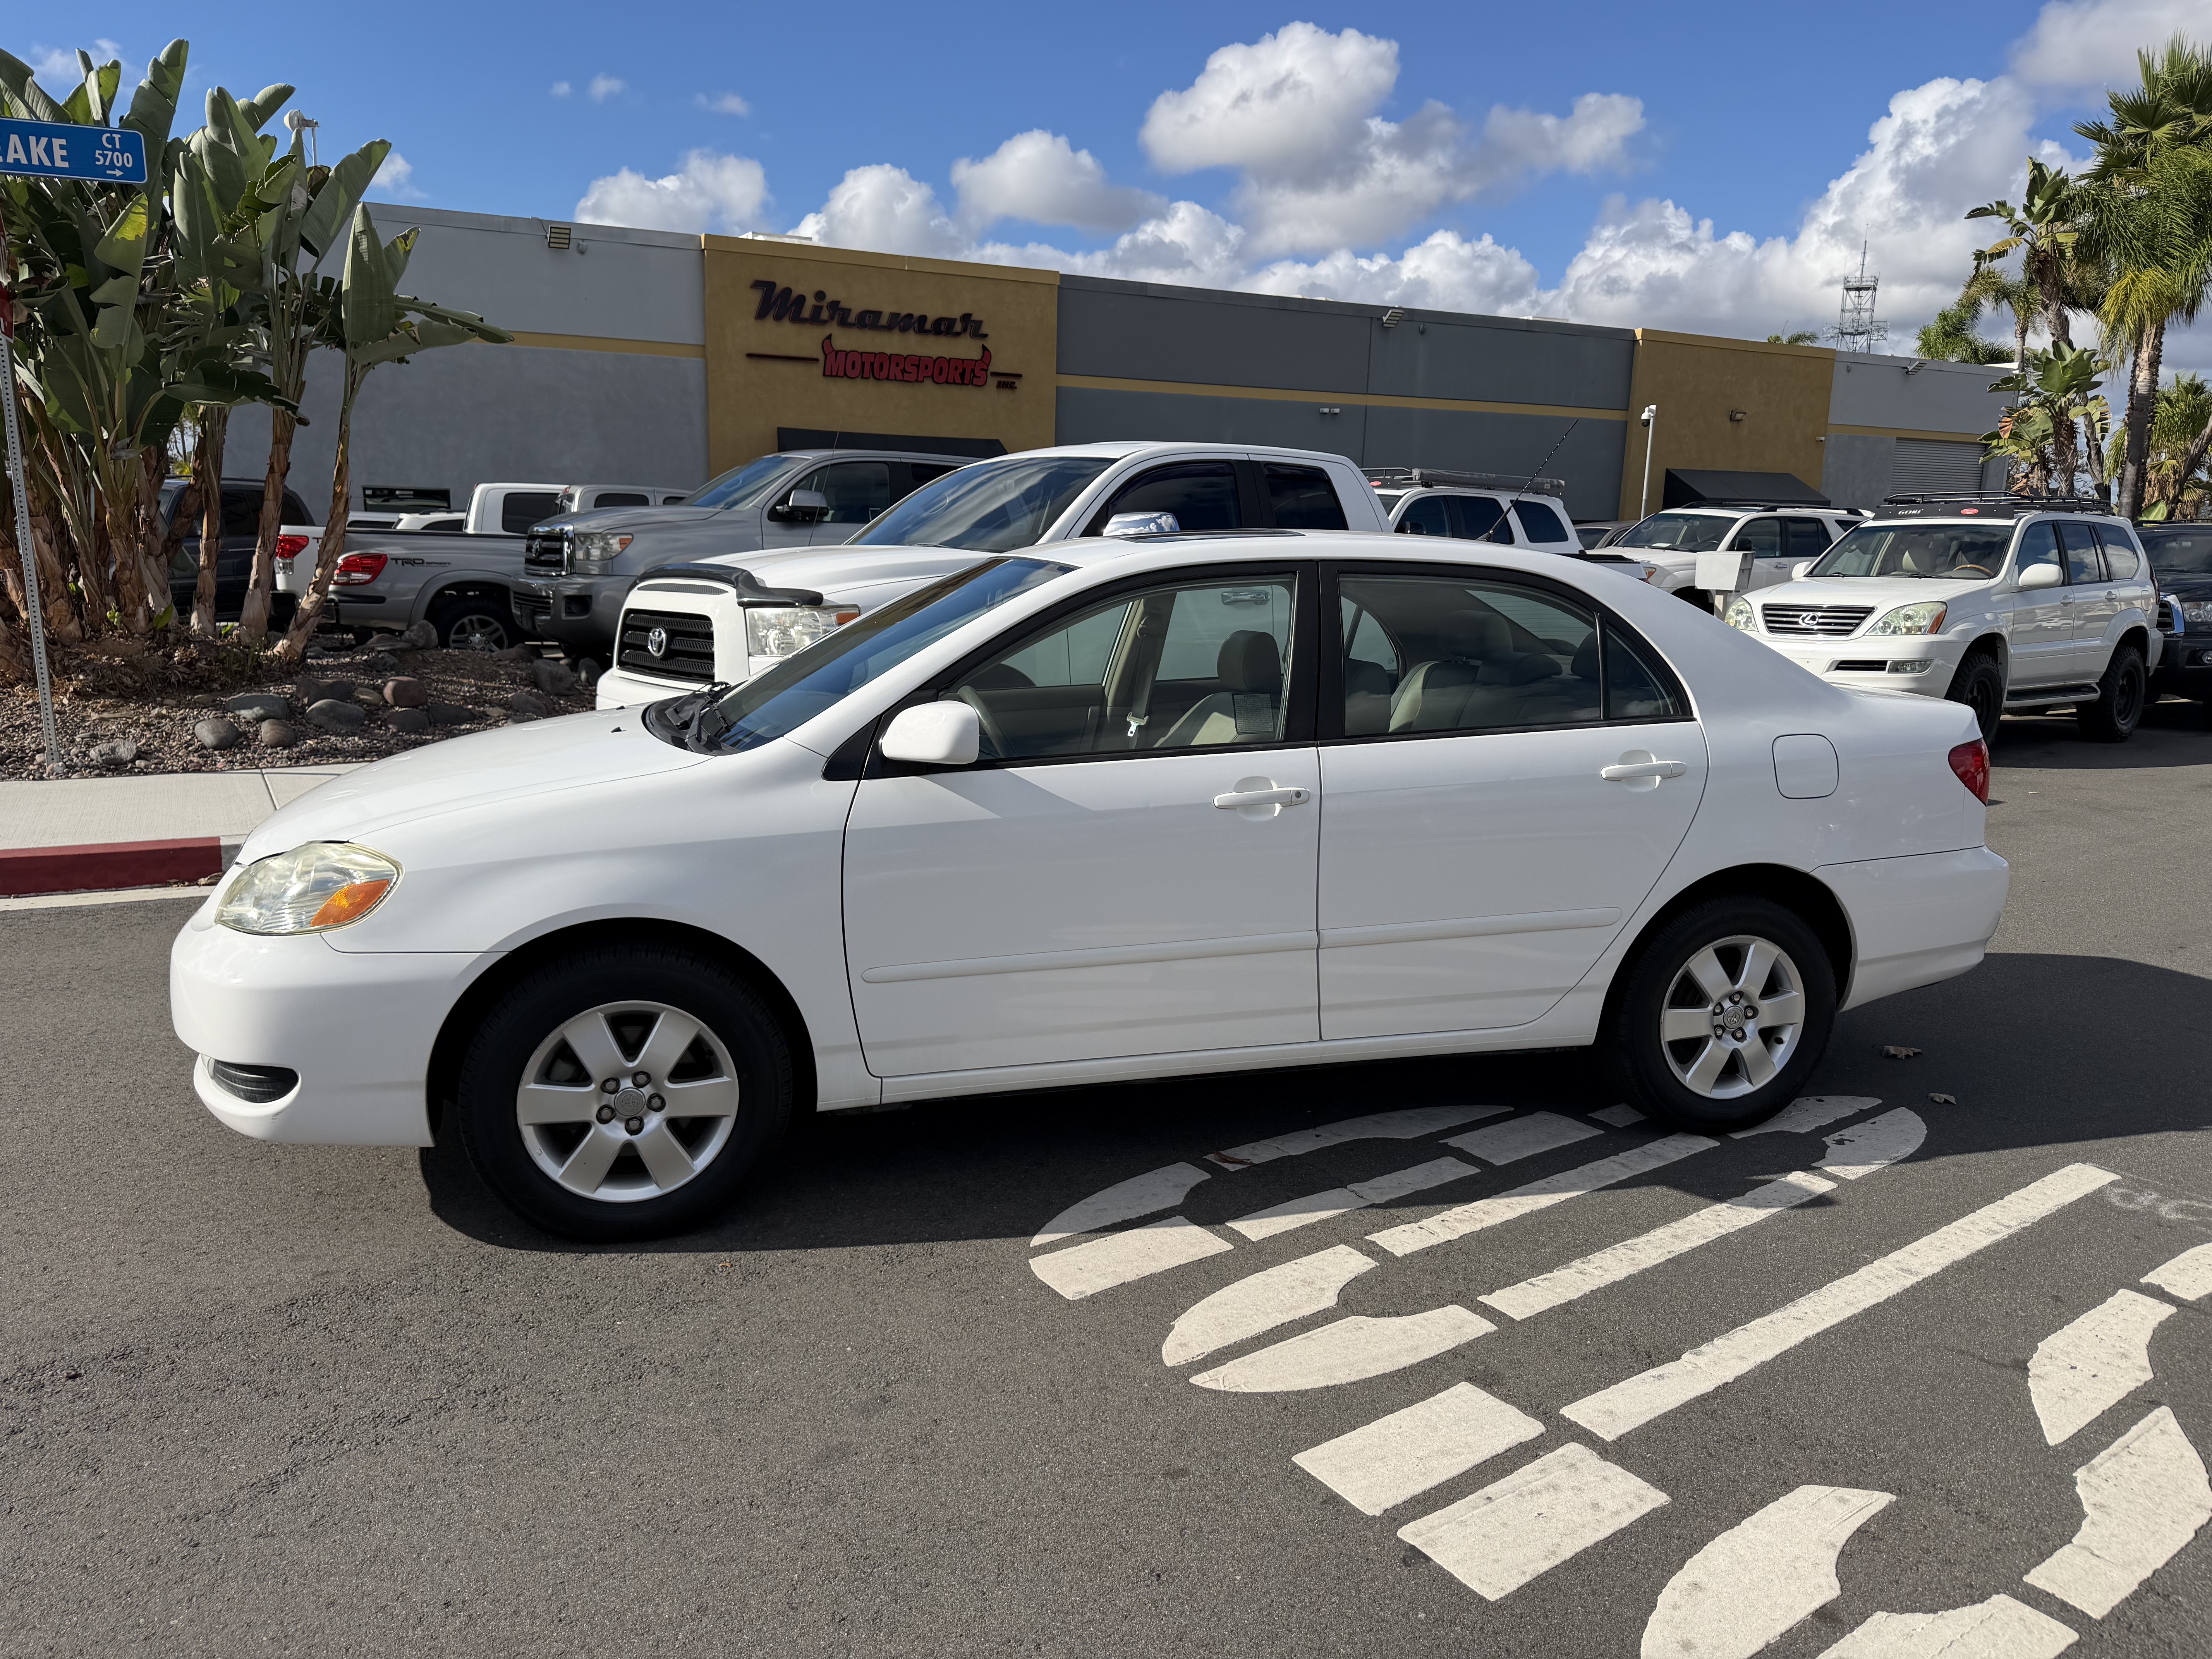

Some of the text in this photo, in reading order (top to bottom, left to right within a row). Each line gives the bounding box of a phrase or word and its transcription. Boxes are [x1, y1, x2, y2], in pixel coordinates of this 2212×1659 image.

[102, 133, 121, 149] CT
[0, 134, 69, 168] AKE
[95, 150, 133, 168] 5700
[750, 279, 989, 338] Miramar
[823, 349, 991, 386] MOTORSPORTS
[996, 380, 1017, 389] INC.
[391, 558, 424, 567] TRD
